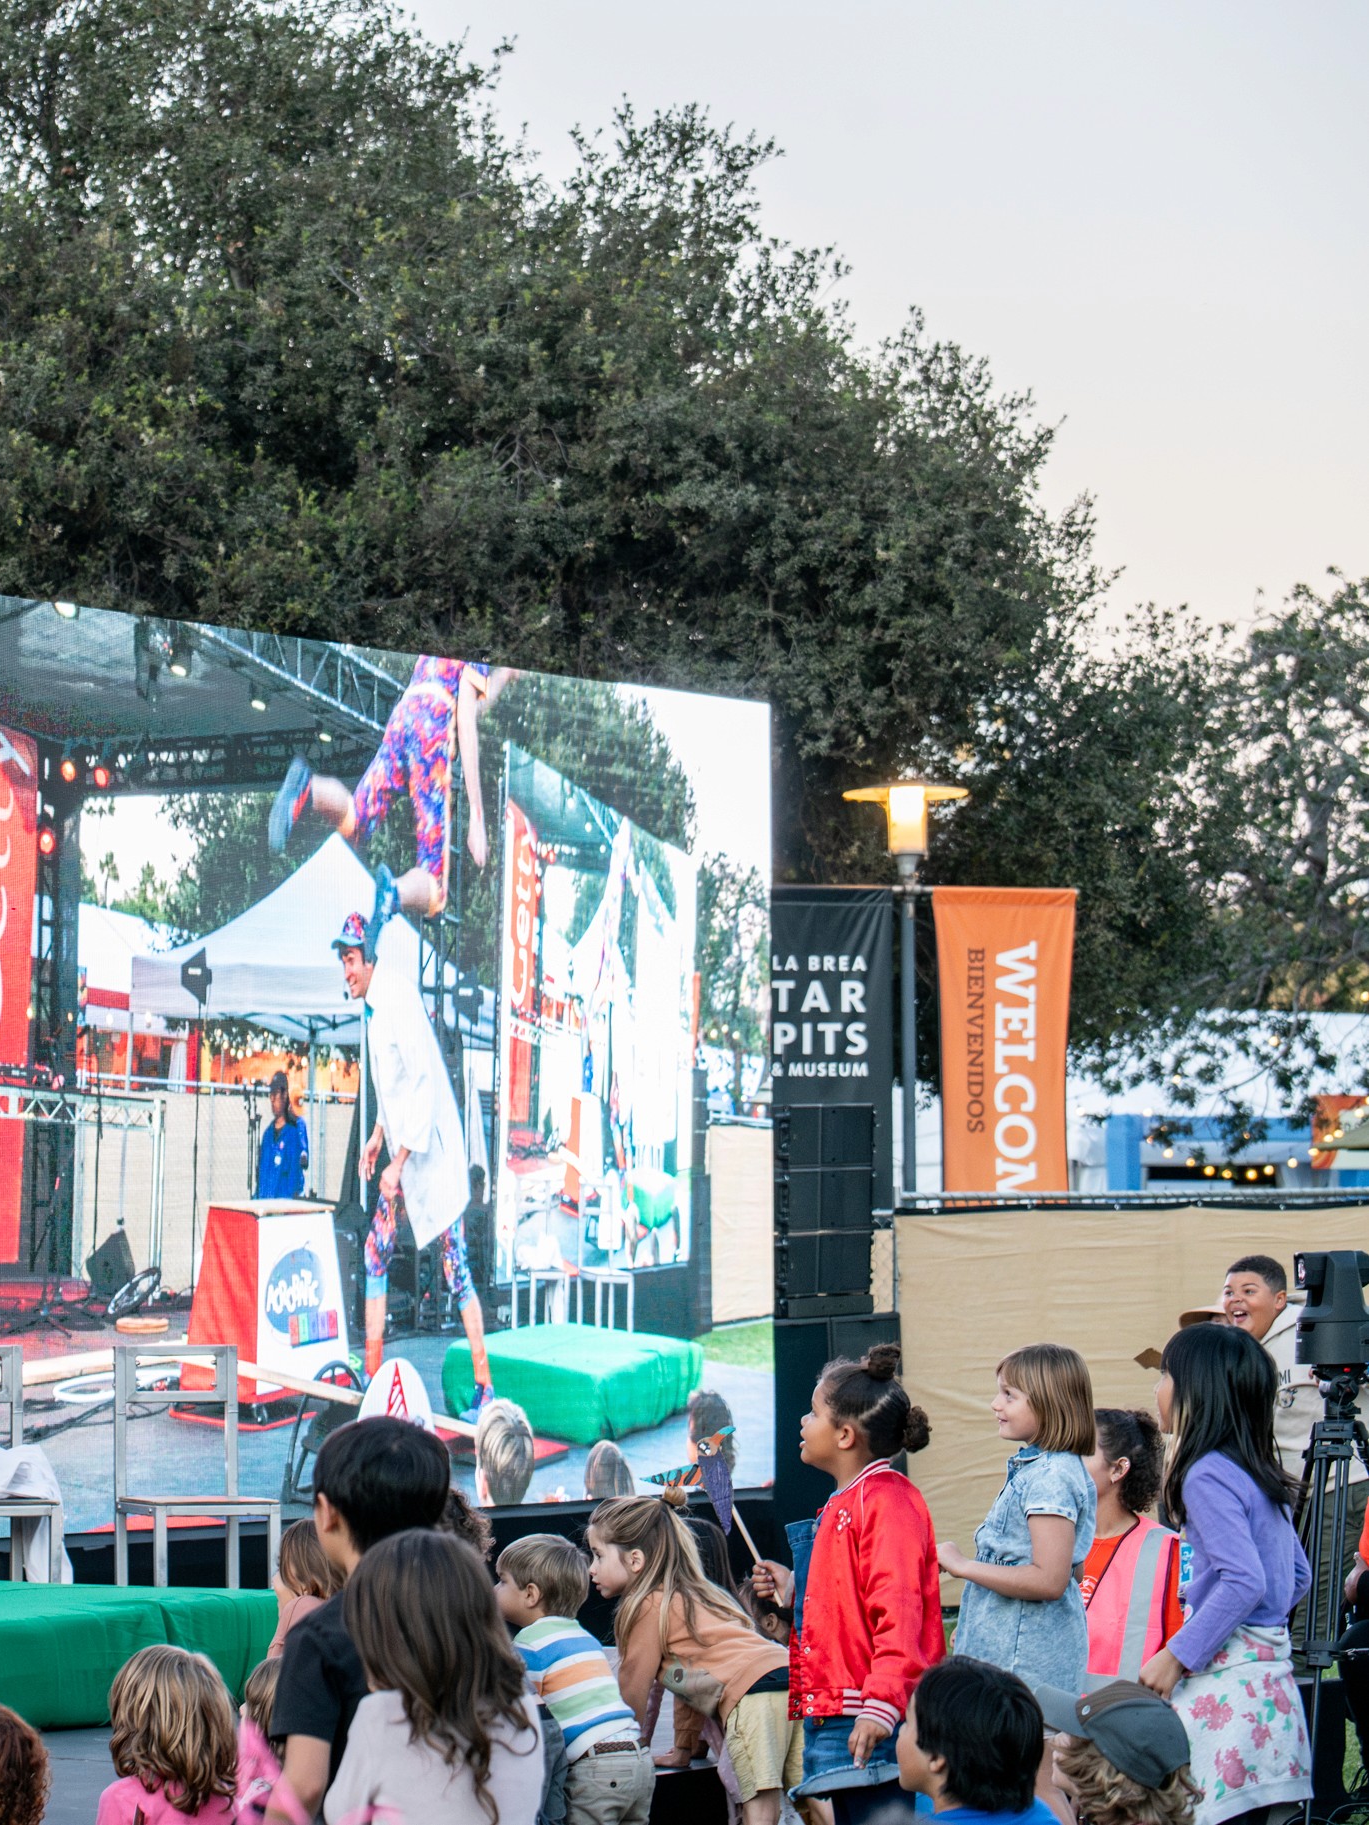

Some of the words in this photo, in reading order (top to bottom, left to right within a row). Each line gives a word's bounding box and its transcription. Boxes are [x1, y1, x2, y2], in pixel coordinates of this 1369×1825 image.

[772, 955, 799, 971] LA
[808, 955, 867, 971] BREA
[771, 980, 866, 1013] TAR
[773, 1022, 868, 1055] PITS
[967, 948, 985, 1134] BIENVENIDOS
[771, 1062, 783, 1077] &
[788, 1062, 868, 1077] MUSEUM
